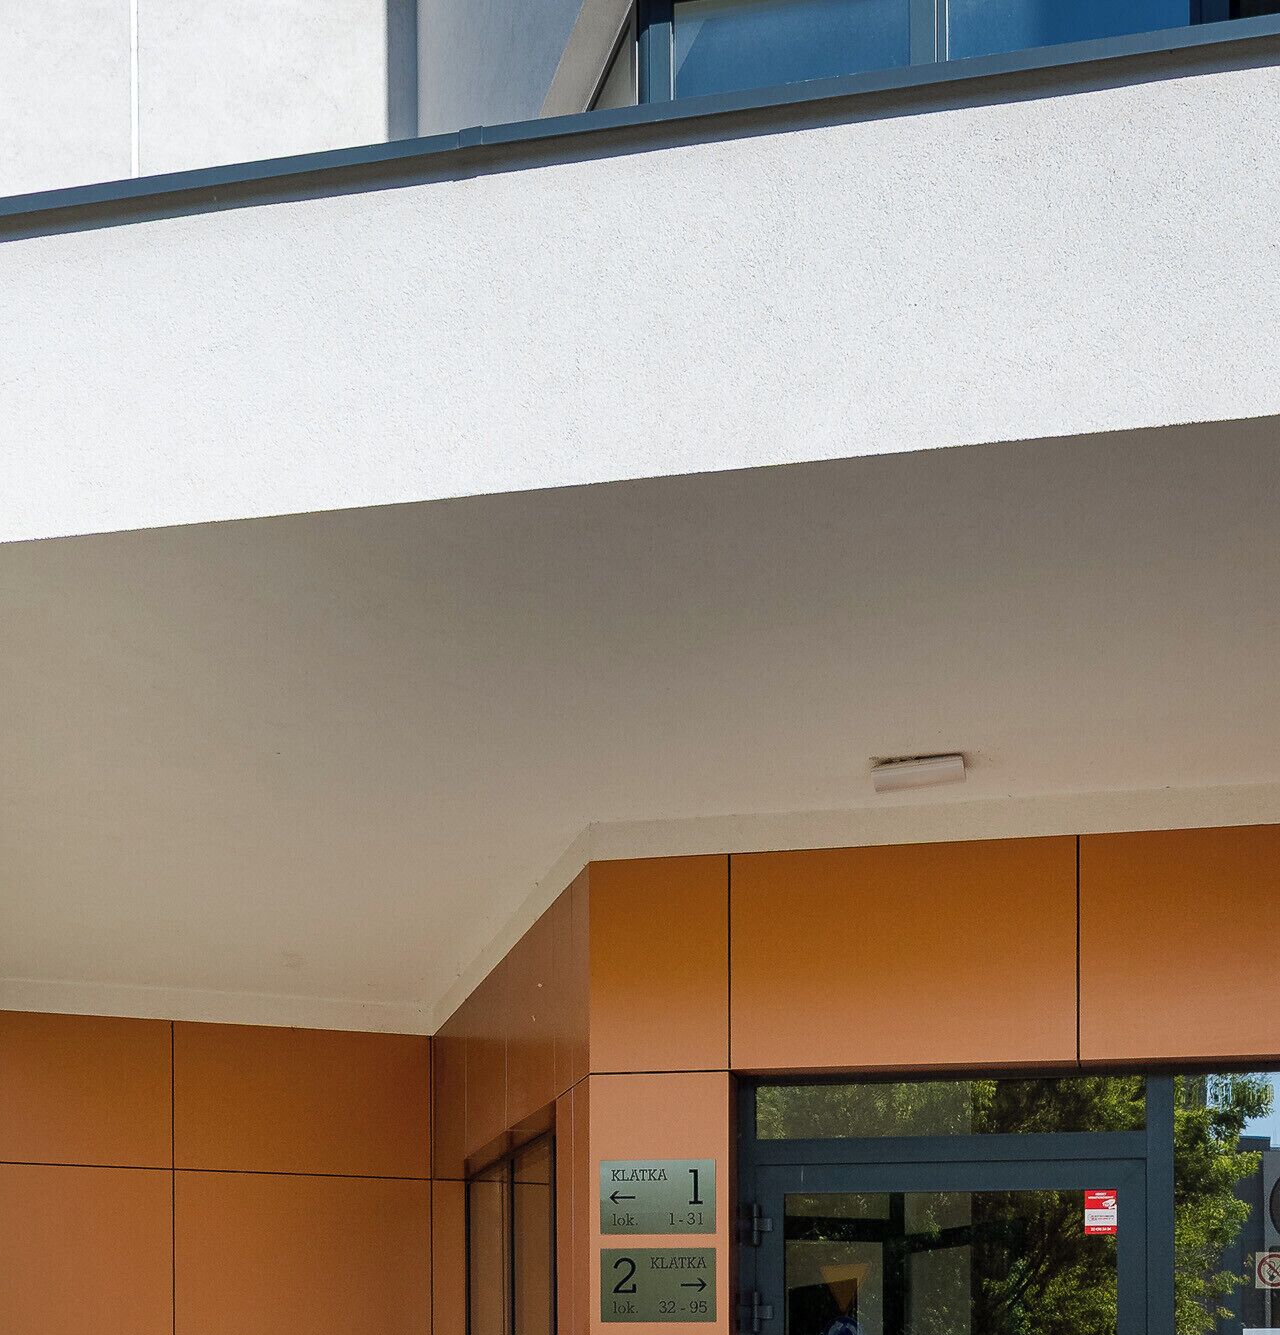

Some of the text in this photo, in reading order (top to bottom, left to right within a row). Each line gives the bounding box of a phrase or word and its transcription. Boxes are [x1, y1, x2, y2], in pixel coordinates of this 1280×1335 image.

[611, 1169, 703, 1205] KLATKA 1
[612, 1213, 639, 1226] lok.
[612, 1256, 707, 1294] 2 KLATKA
[612, 1301, 639, 1314] lok.
